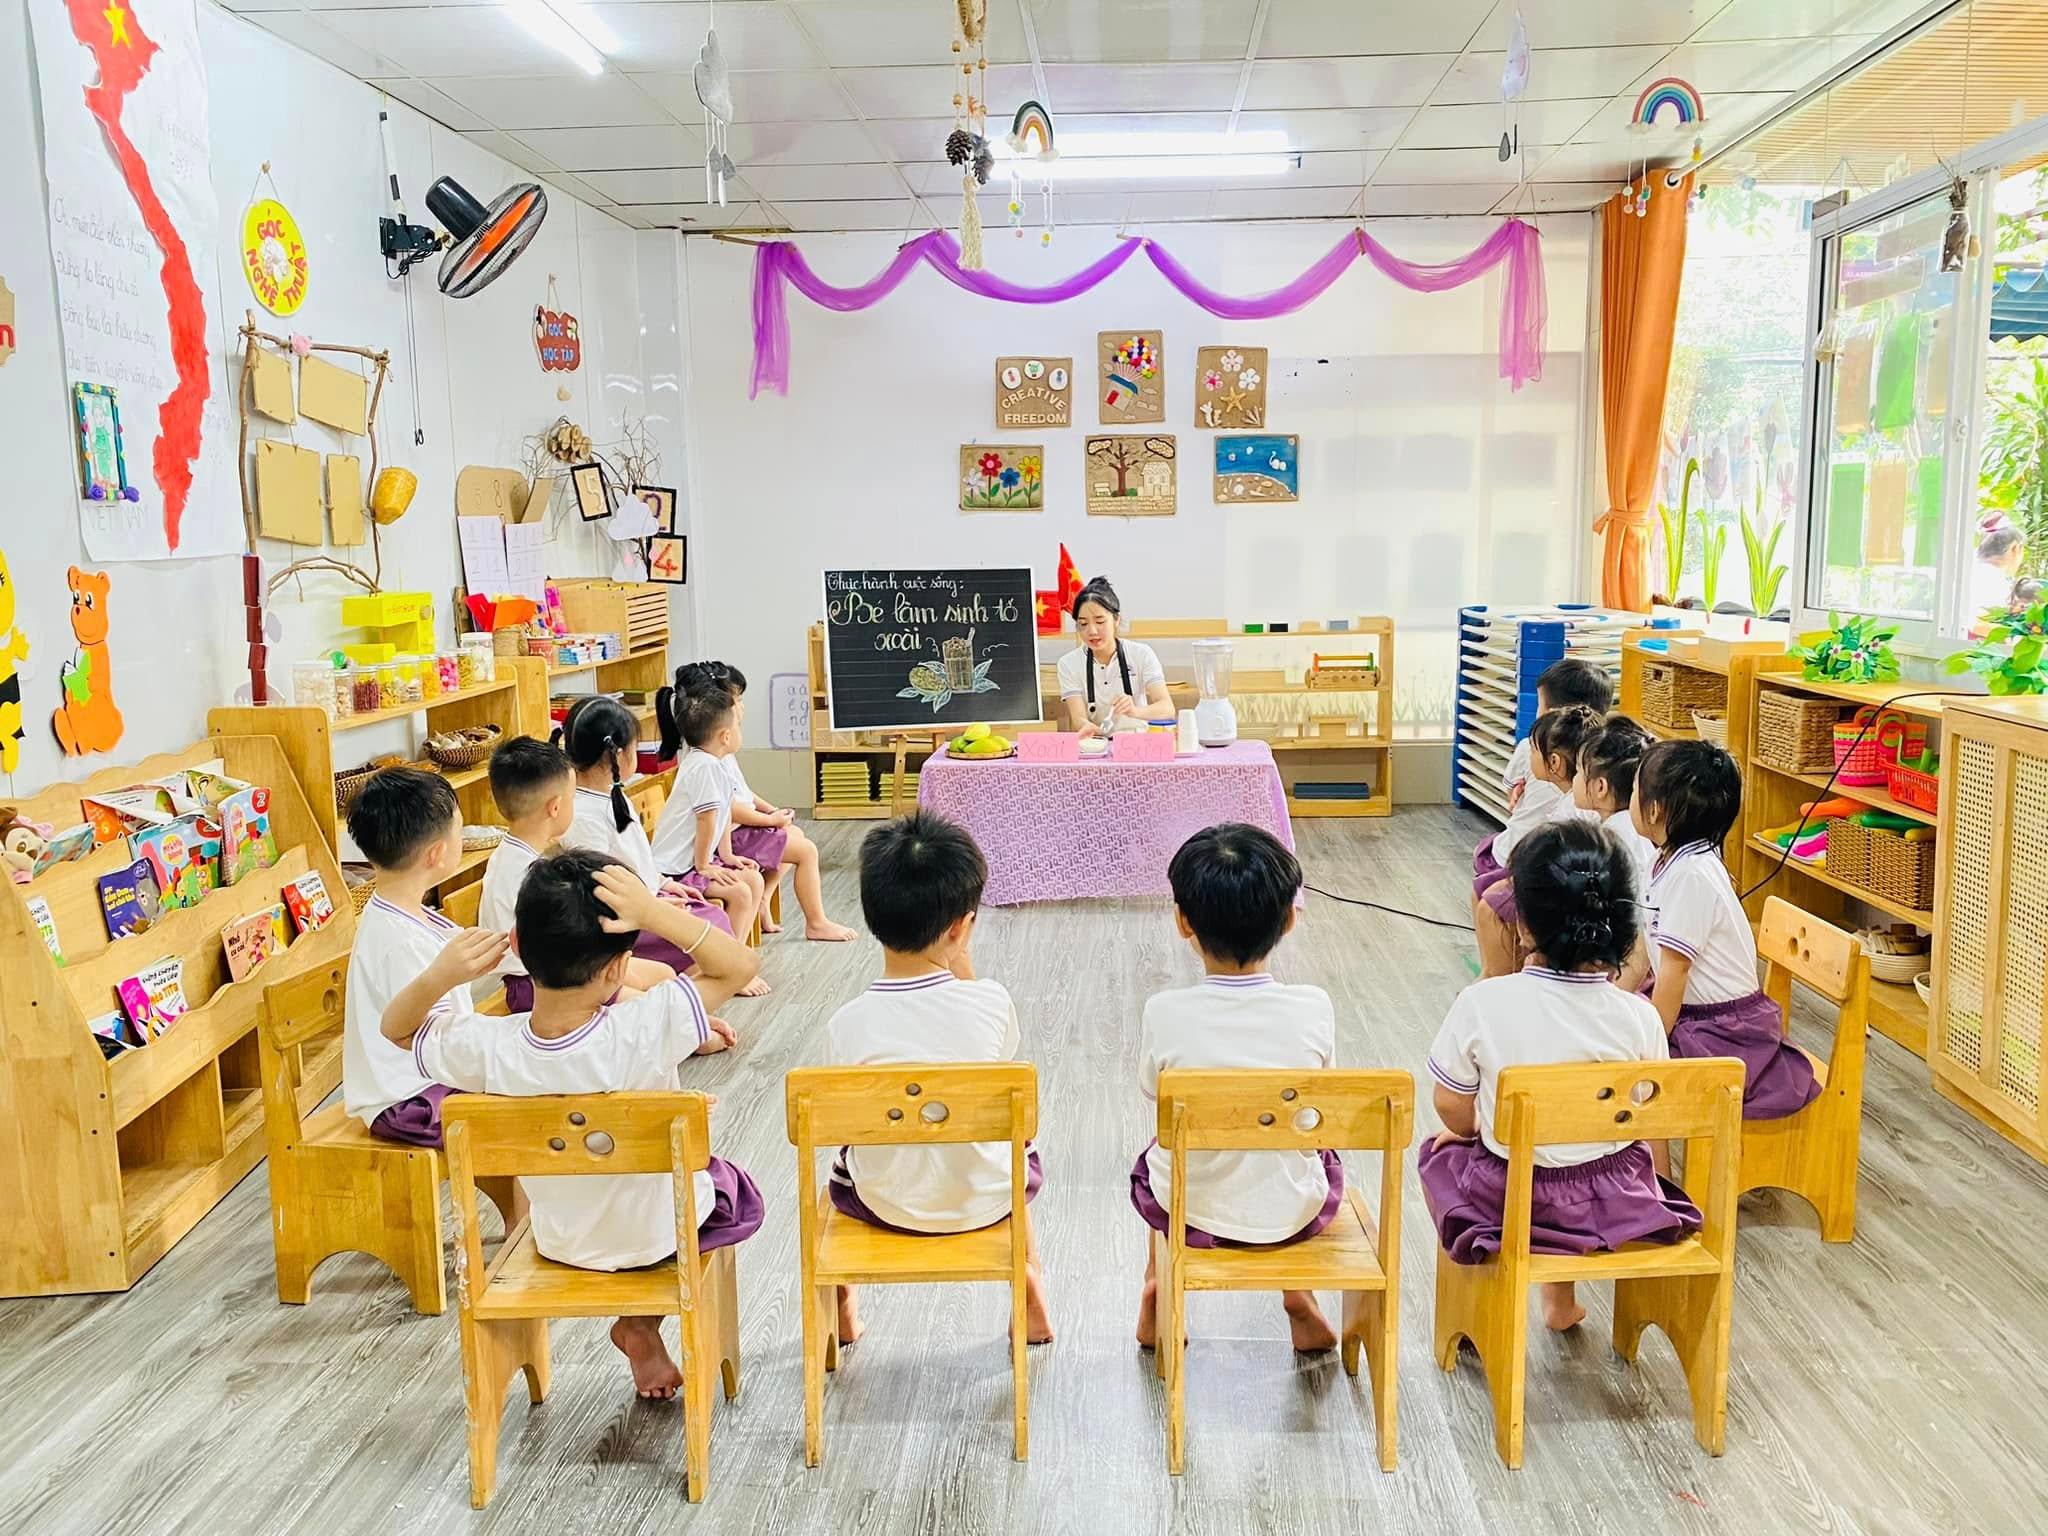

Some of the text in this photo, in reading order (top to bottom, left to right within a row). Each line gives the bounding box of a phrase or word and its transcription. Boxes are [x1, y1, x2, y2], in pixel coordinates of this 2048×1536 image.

[257, 208, 286, 240] GÓC
[246, 248, 280, 308] NGHỆ
[283, 241, 307, 308] THUẬT
[548, 318, 564, 337] GÓC
[543, 344, 575, 367] HỌC TẬP
[1001, 387, 1067, 411] CREATIVE
[1004, 413, 1067, 424] FREEDOM
[654, 543, 679, 577] 4
[827, 572, 964, 598] Thực hành cuộc sống:
[828, 591, 1019, 625] Bé làm sinh tố
[874, 627, 923, 651] xoài
[1025, 736, 1064, 759] Xoài
[257, 793, 266, 807] 2
